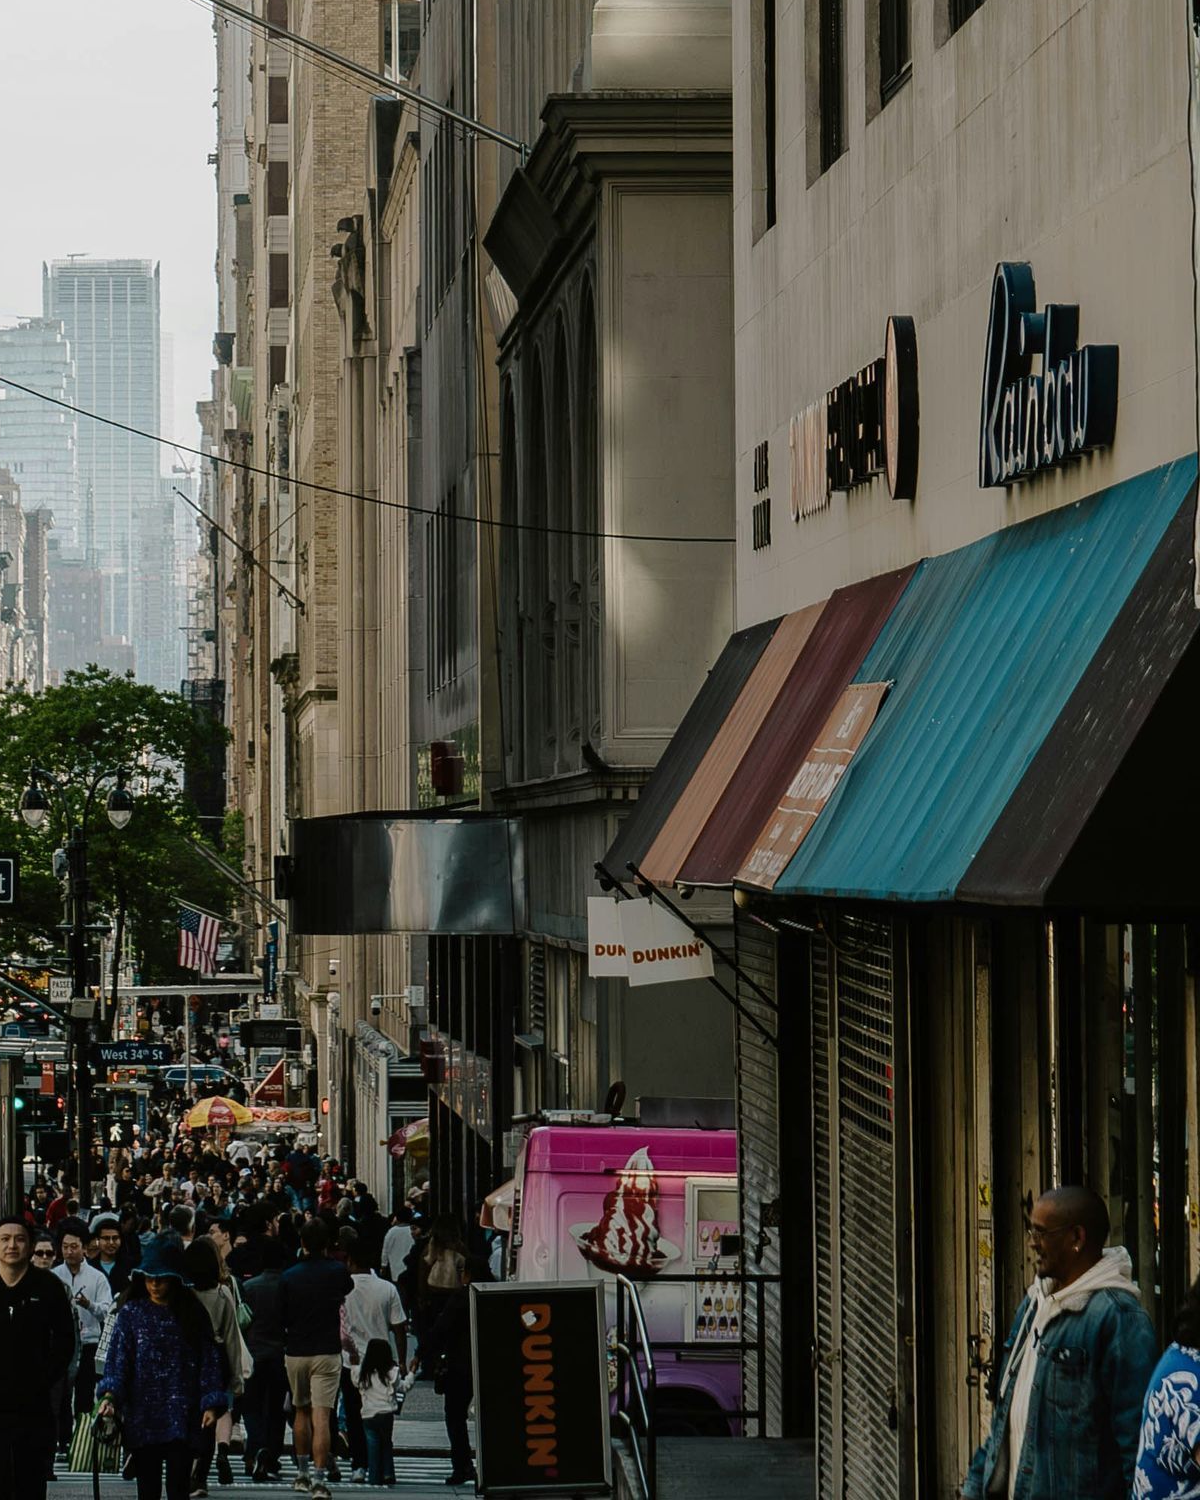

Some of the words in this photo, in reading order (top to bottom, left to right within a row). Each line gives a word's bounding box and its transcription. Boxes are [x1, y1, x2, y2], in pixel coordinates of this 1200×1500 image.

[979, 261, 1116, 488] Rainbow
[595, 944, 626, 956] DUN
[632, 942, 704, 964] DUNKIN'
[52, 980, 71, 989] PASSE
[101, 1049, 128, 1060] West
[130, 1049, 150, 1060] 34th
[152, 1050, 164, 1060] St
[520, 1303, 558, 1477] DUNKIN'
